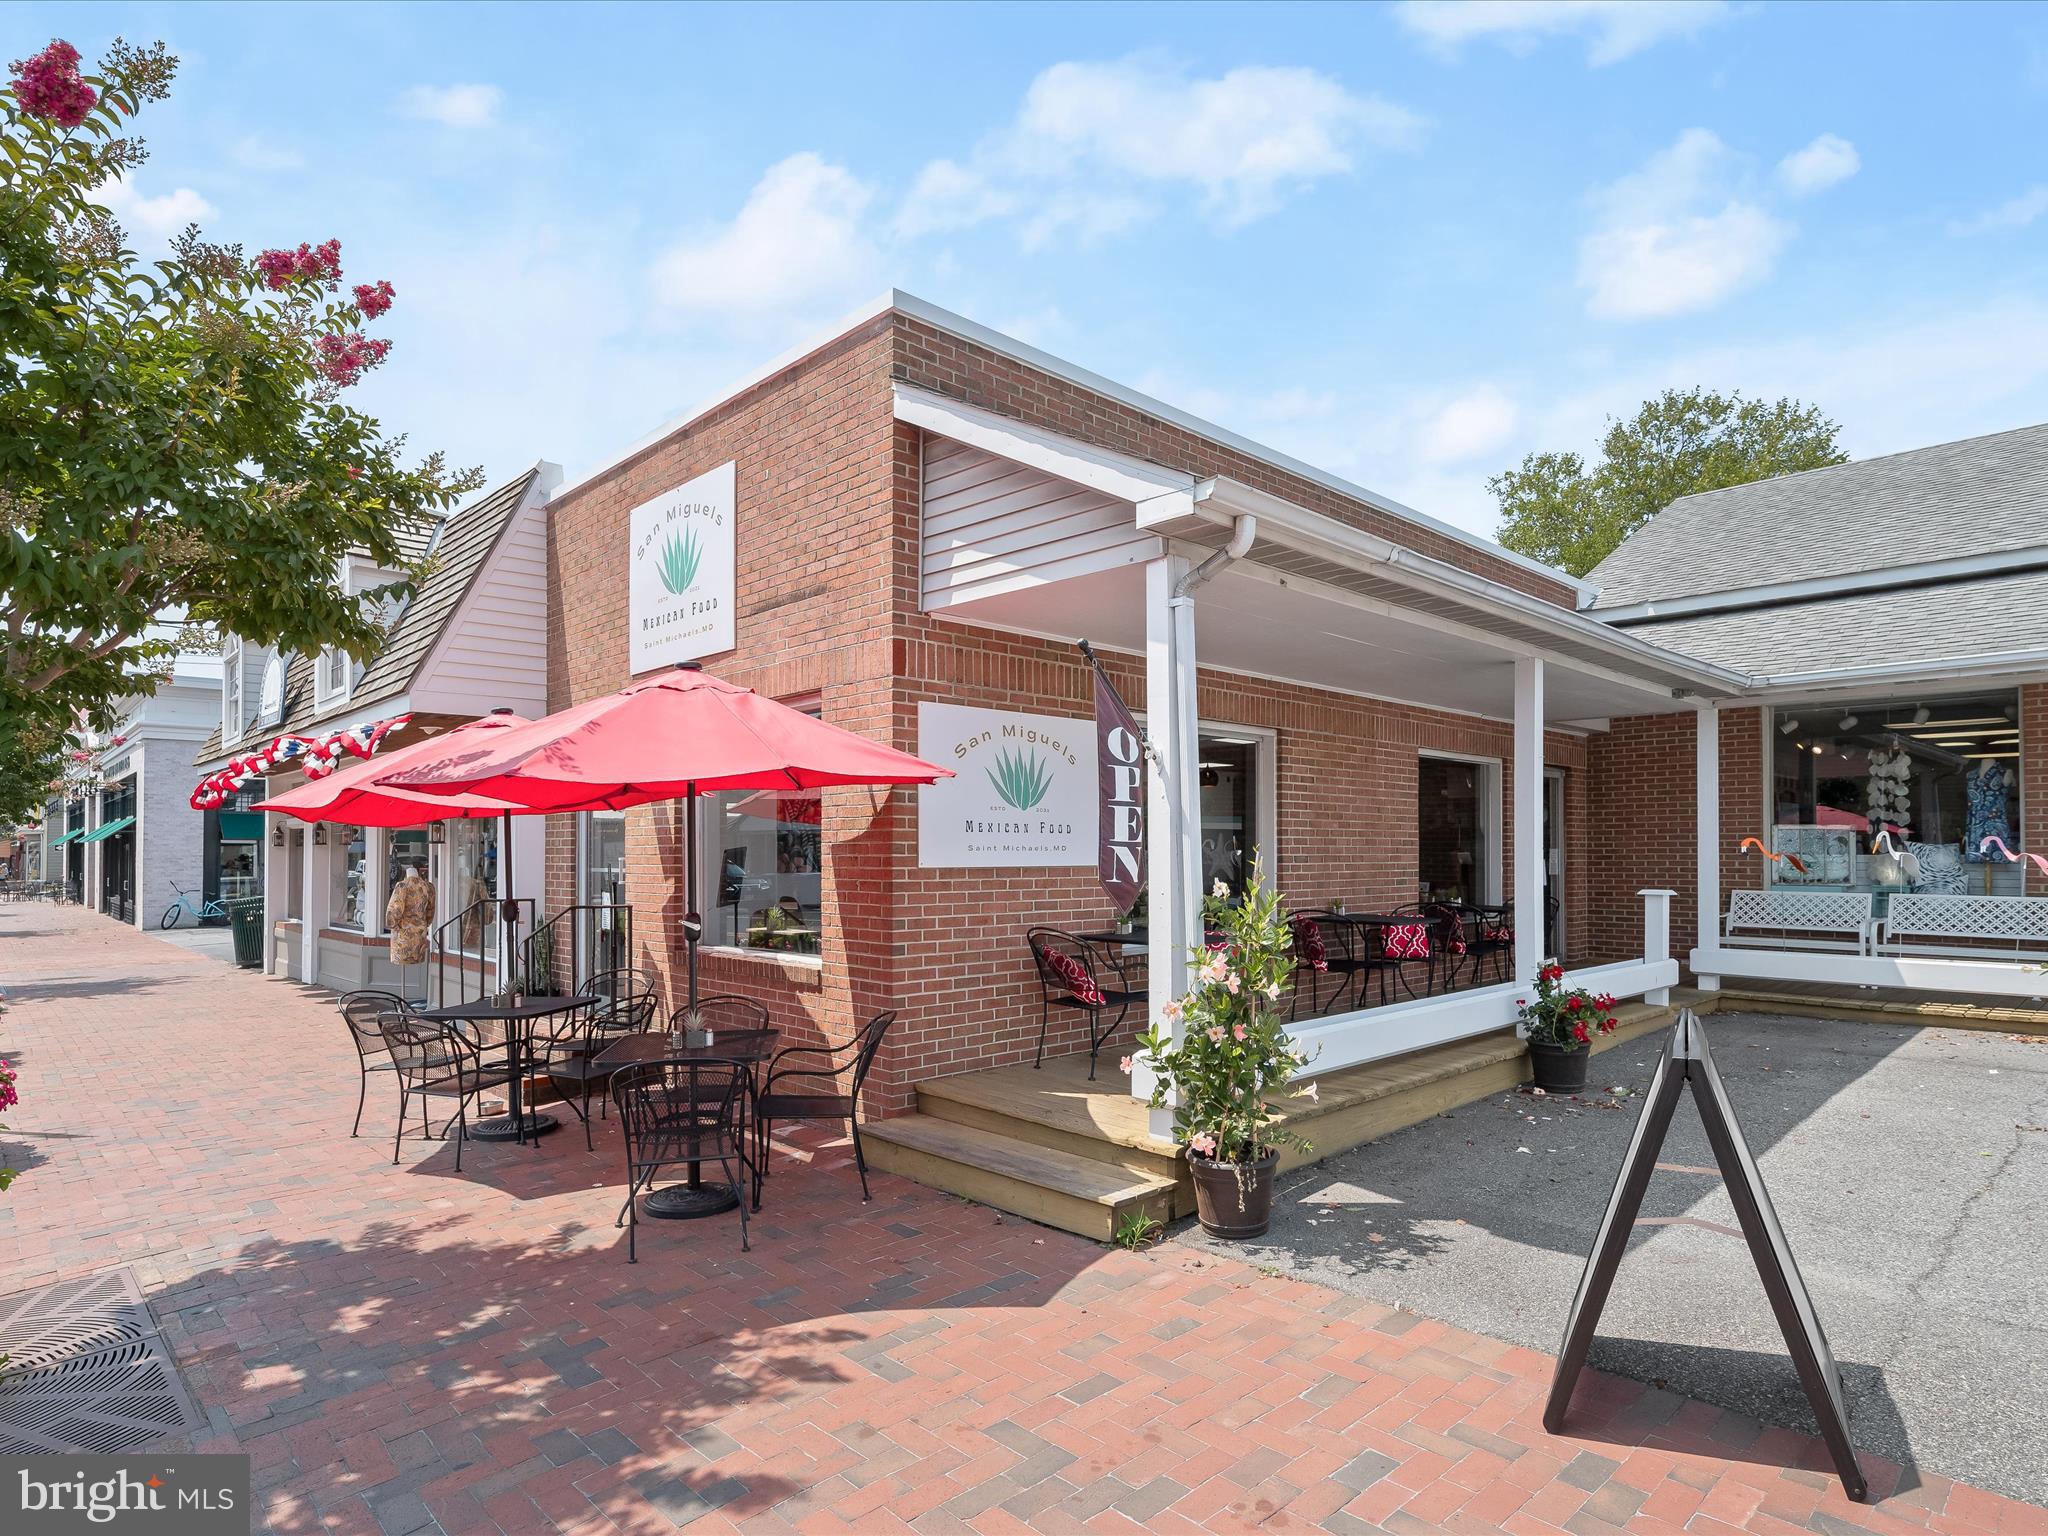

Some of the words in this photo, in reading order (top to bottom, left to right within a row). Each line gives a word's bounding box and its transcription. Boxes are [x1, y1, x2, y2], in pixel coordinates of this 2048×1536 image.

[637, 523, 661, 561] San
[666, 503, 723, 527] Miguels
[644, 639, 663, 650] Saint
[954, 730, 992, 759] San
[1002, 724, 1077, 766] Miguels
[1105, 726, 1143, 883] OPEN
[967, 844, 998, 852] Saint
